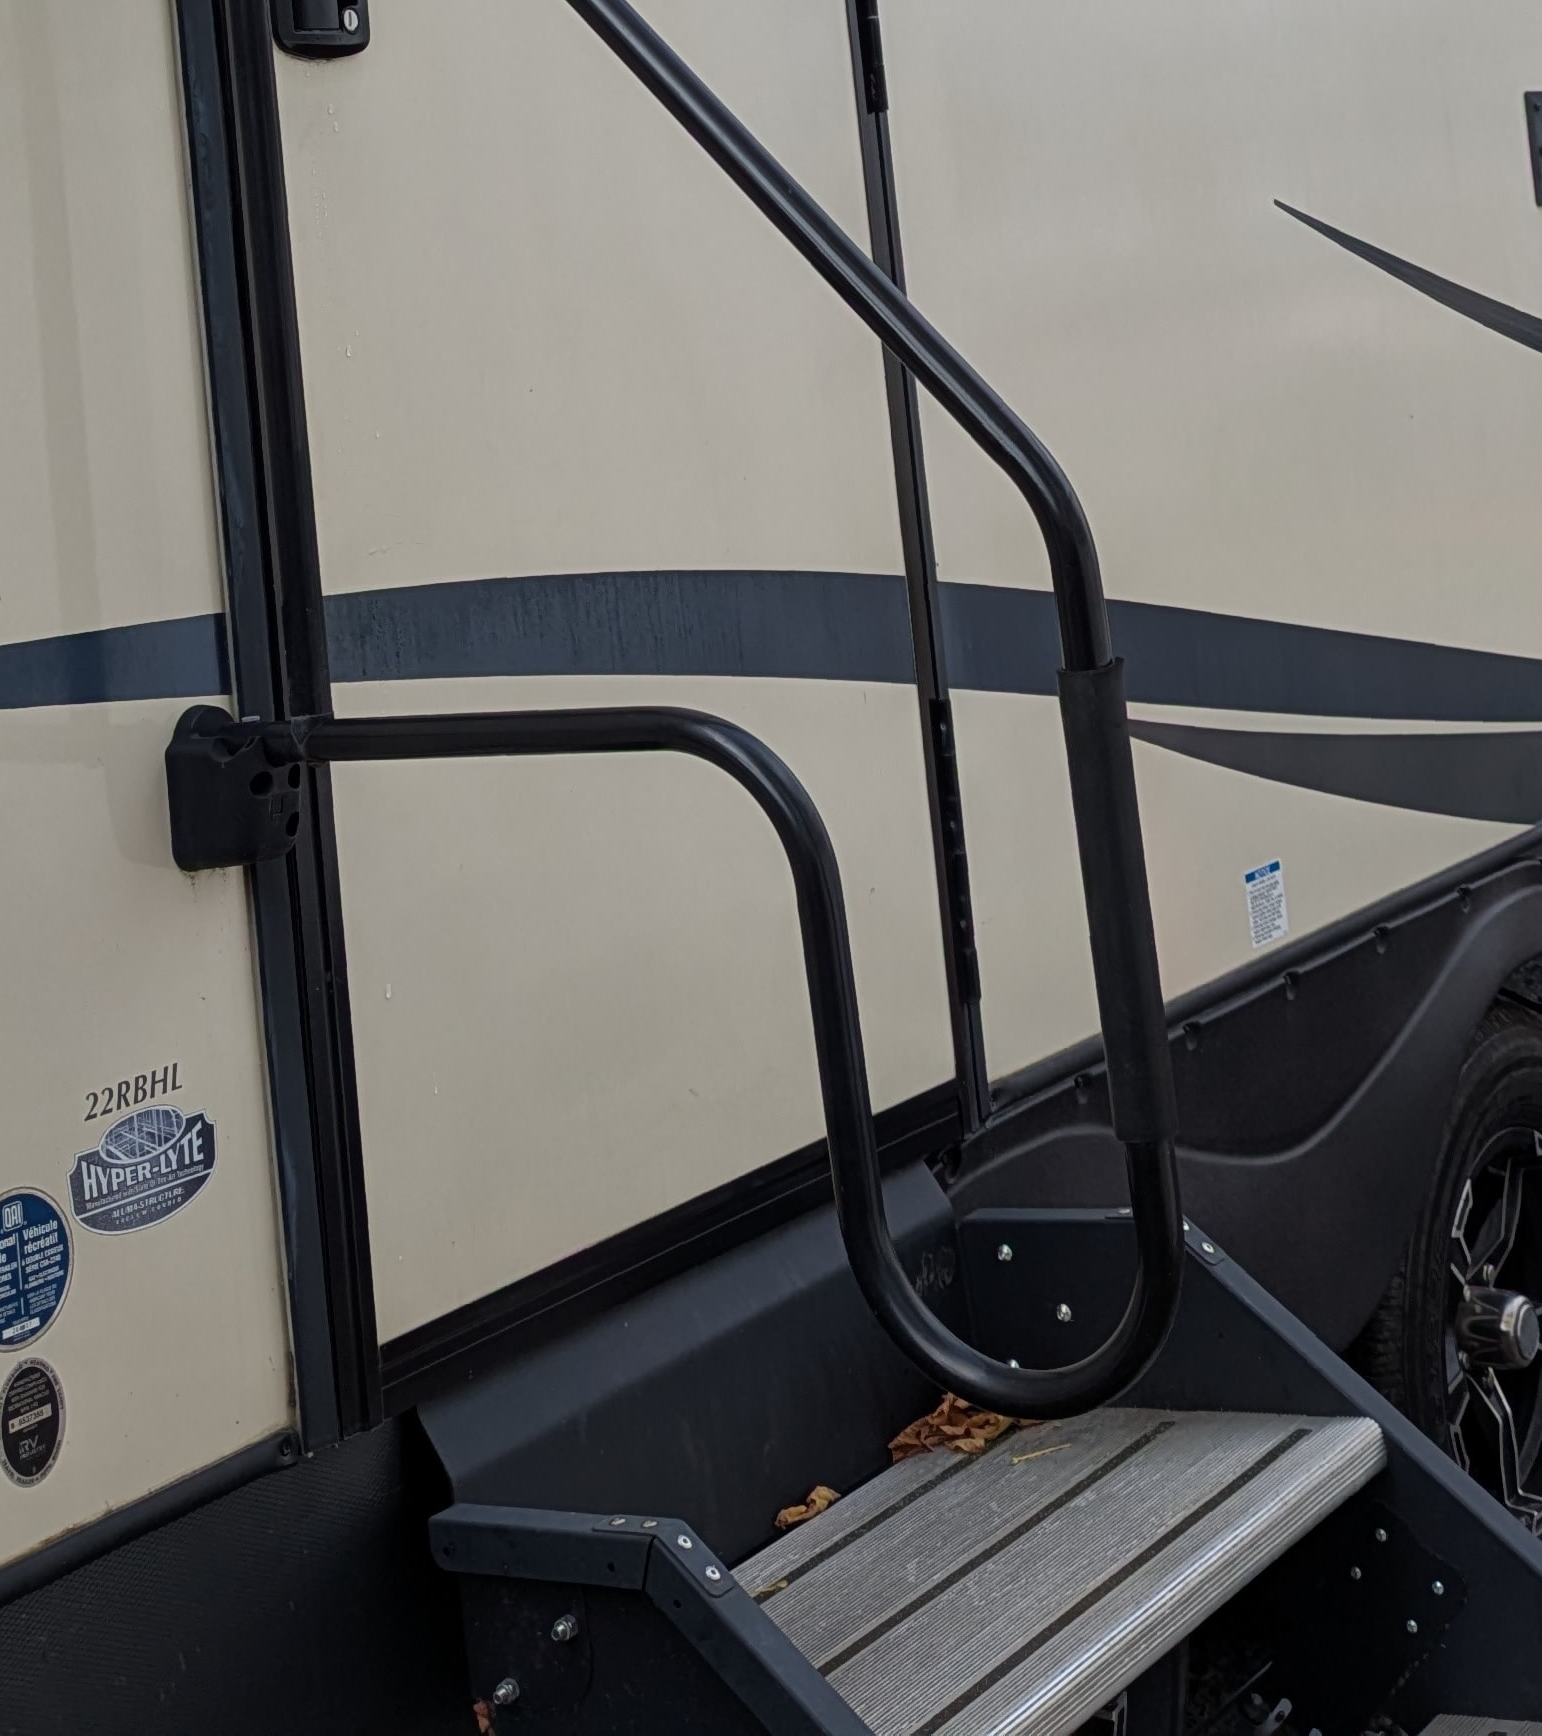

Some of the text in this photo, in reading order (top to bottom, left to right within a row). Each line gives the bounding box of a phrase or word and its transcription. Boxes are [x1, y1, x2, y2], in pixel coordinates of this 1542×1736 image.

[84, 1063, 182, 1121] 22RBHL
[81, 1120, 203, 1201] HYPER-LYTE
[23, 1220, 58, 1240] Véhicule
[24, 1232, 58, 1254] récréatif
